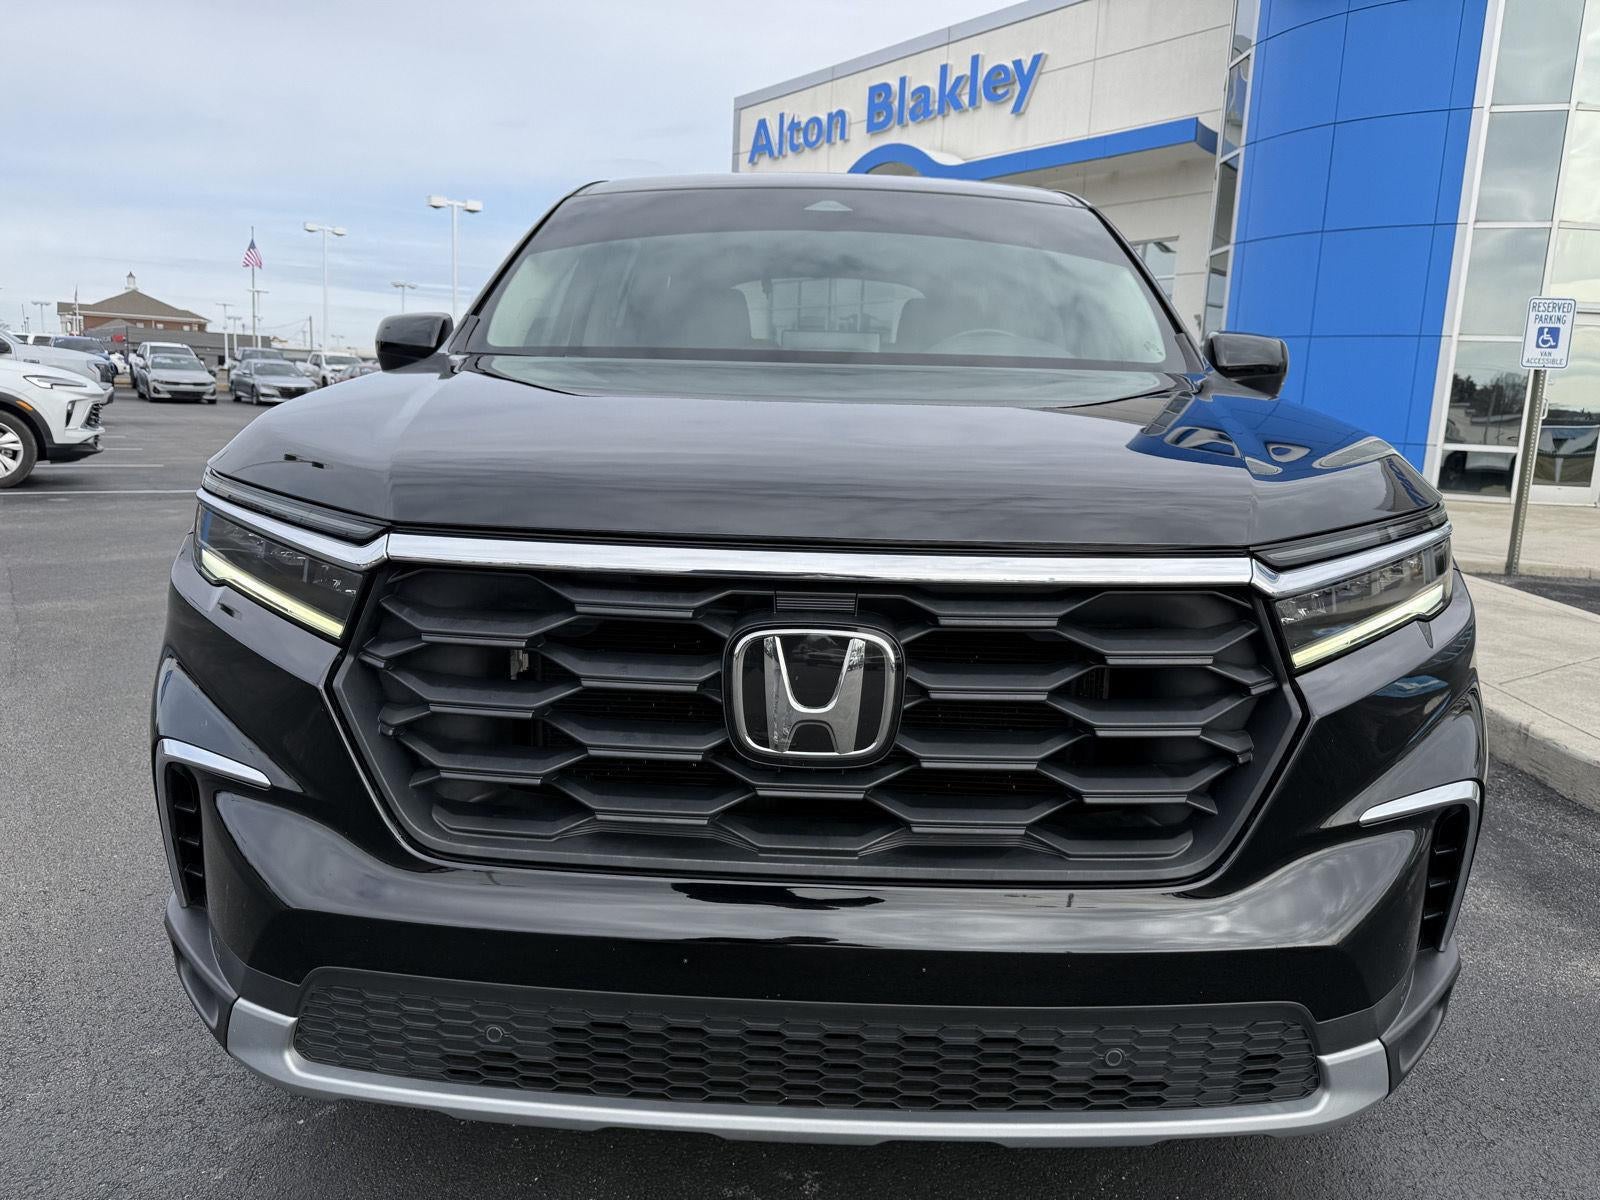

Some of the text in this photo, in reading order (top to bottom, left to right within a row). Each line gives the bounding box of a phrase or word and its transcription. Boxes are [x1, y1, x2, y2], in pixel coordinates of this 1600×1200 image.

[748, 52, 1047, 164] Alton Blakley
[1531, 301, 1573, 313] RESERVED
[1534, 314, 1567, 325] PARKING
[1525, 357, 1564, 366] ACCESSIBLE
